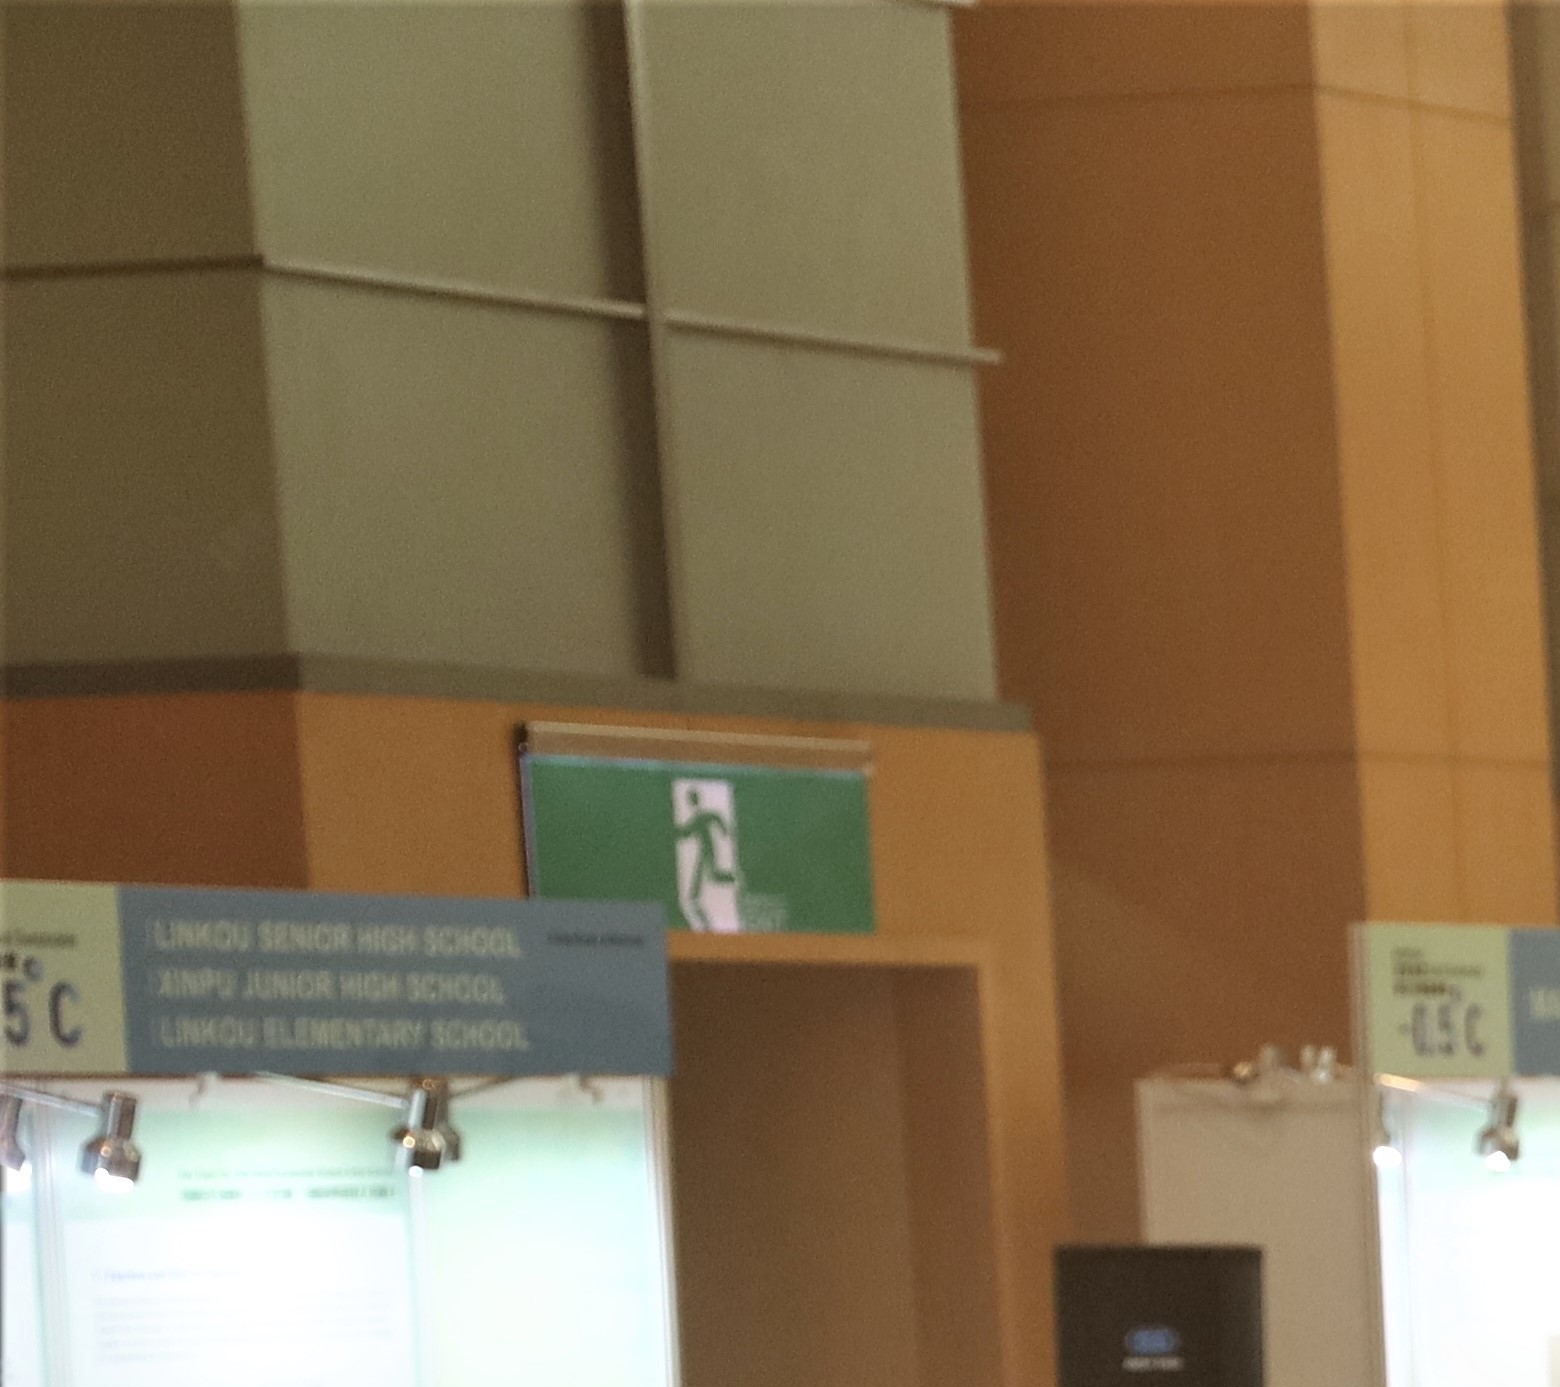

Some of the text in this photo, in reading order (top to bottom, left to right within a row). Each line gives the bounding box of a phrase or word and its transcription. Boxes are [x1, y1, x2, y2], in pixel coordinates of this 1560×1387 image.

[154, 920, 520, 957] LINKOU SENIOR HIGH SCHOOL
[246, 969, 336, 999] JUNIOR
[340, 972, 402, 1000] HIGH
[406, 974, 504, 1004] SCHOOL
[160, 1016, 530, 1052] LINKOU ELEMENTARY SCHOOL
